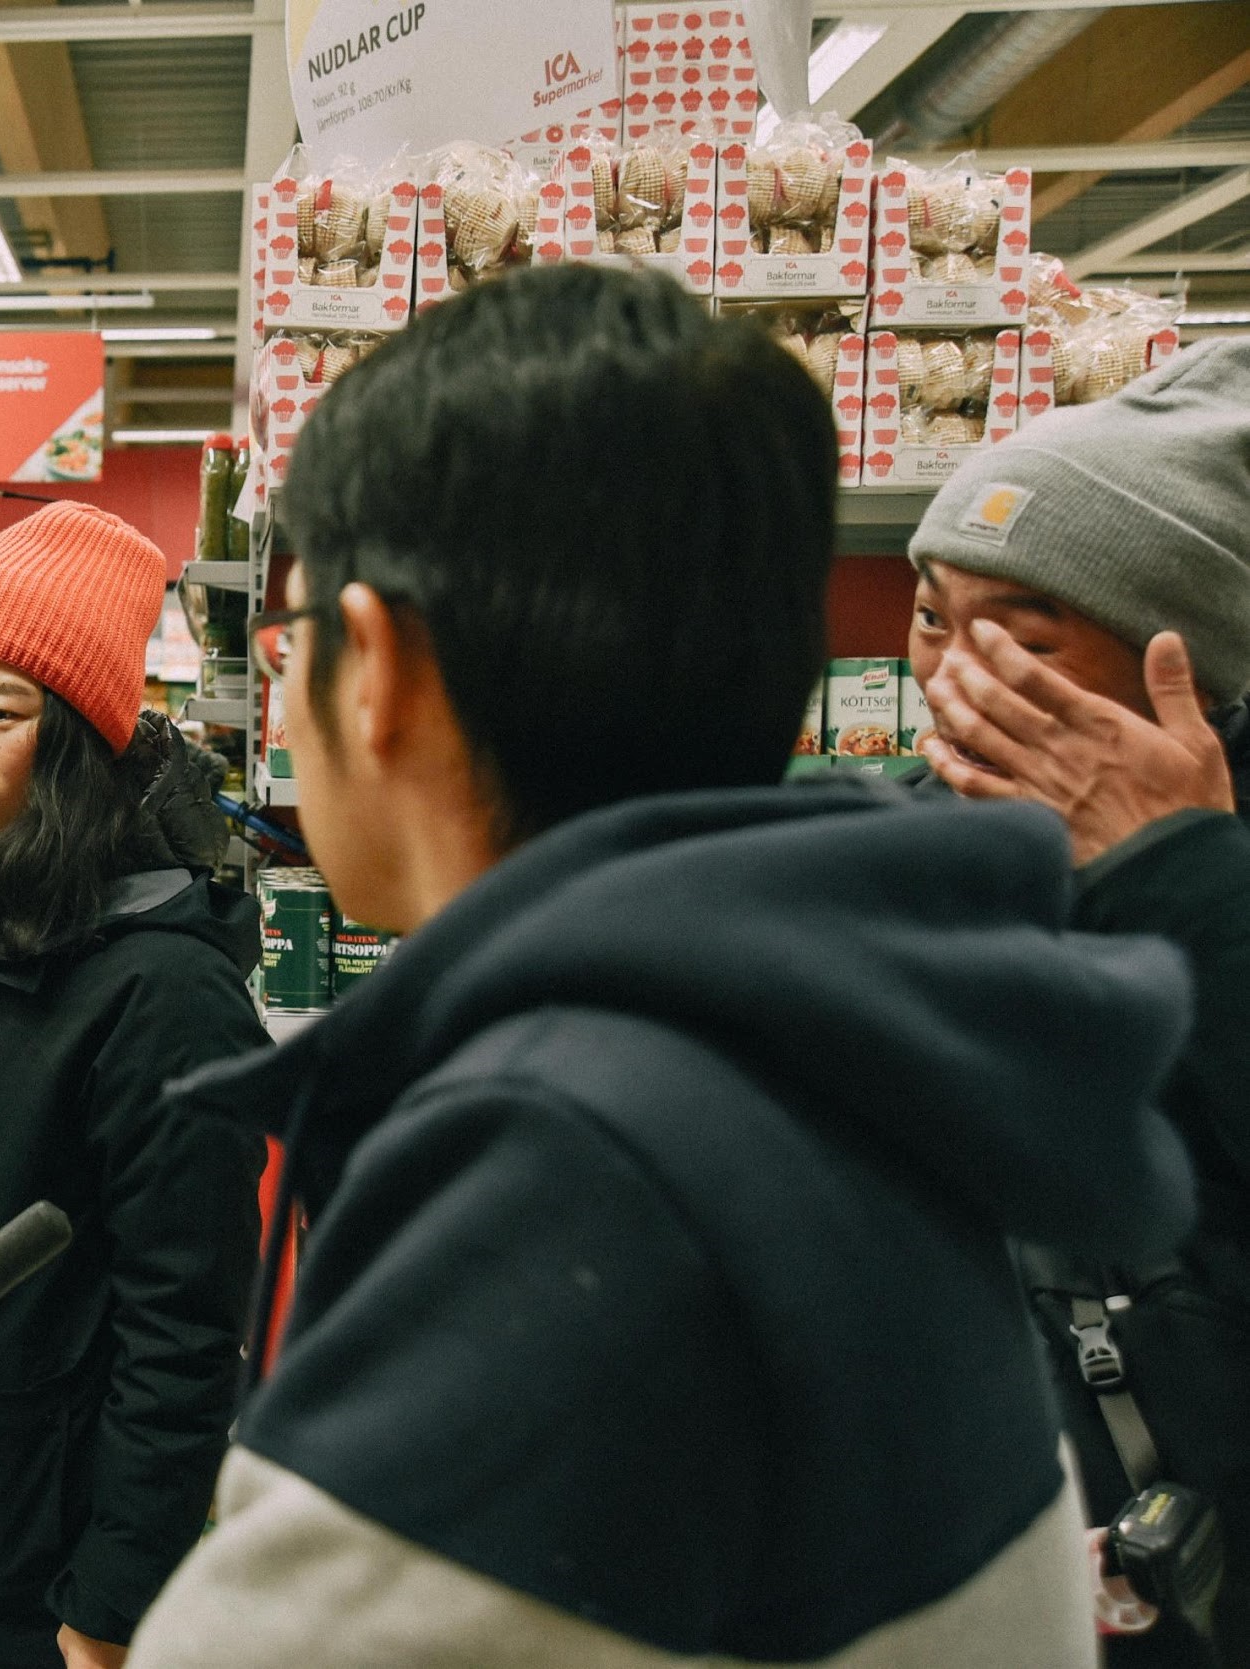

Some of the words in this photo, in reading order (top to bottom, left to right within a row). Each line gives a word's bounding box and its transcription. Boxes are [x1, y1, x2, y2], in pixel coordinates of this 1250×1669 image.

[308, 25, 381, 82] NUDLAR
[386, 2, 425, 42] CUP
[545, 50, 580, 86] ICA
[533, 68, 603, 107] Supermarket
[766, 271, 817, 281] Bakformar
[312, 302, 360, 312] Bakformar
[926, 300, 977, 309] Bakformar
[916, 461, 958, 470] Bakform
